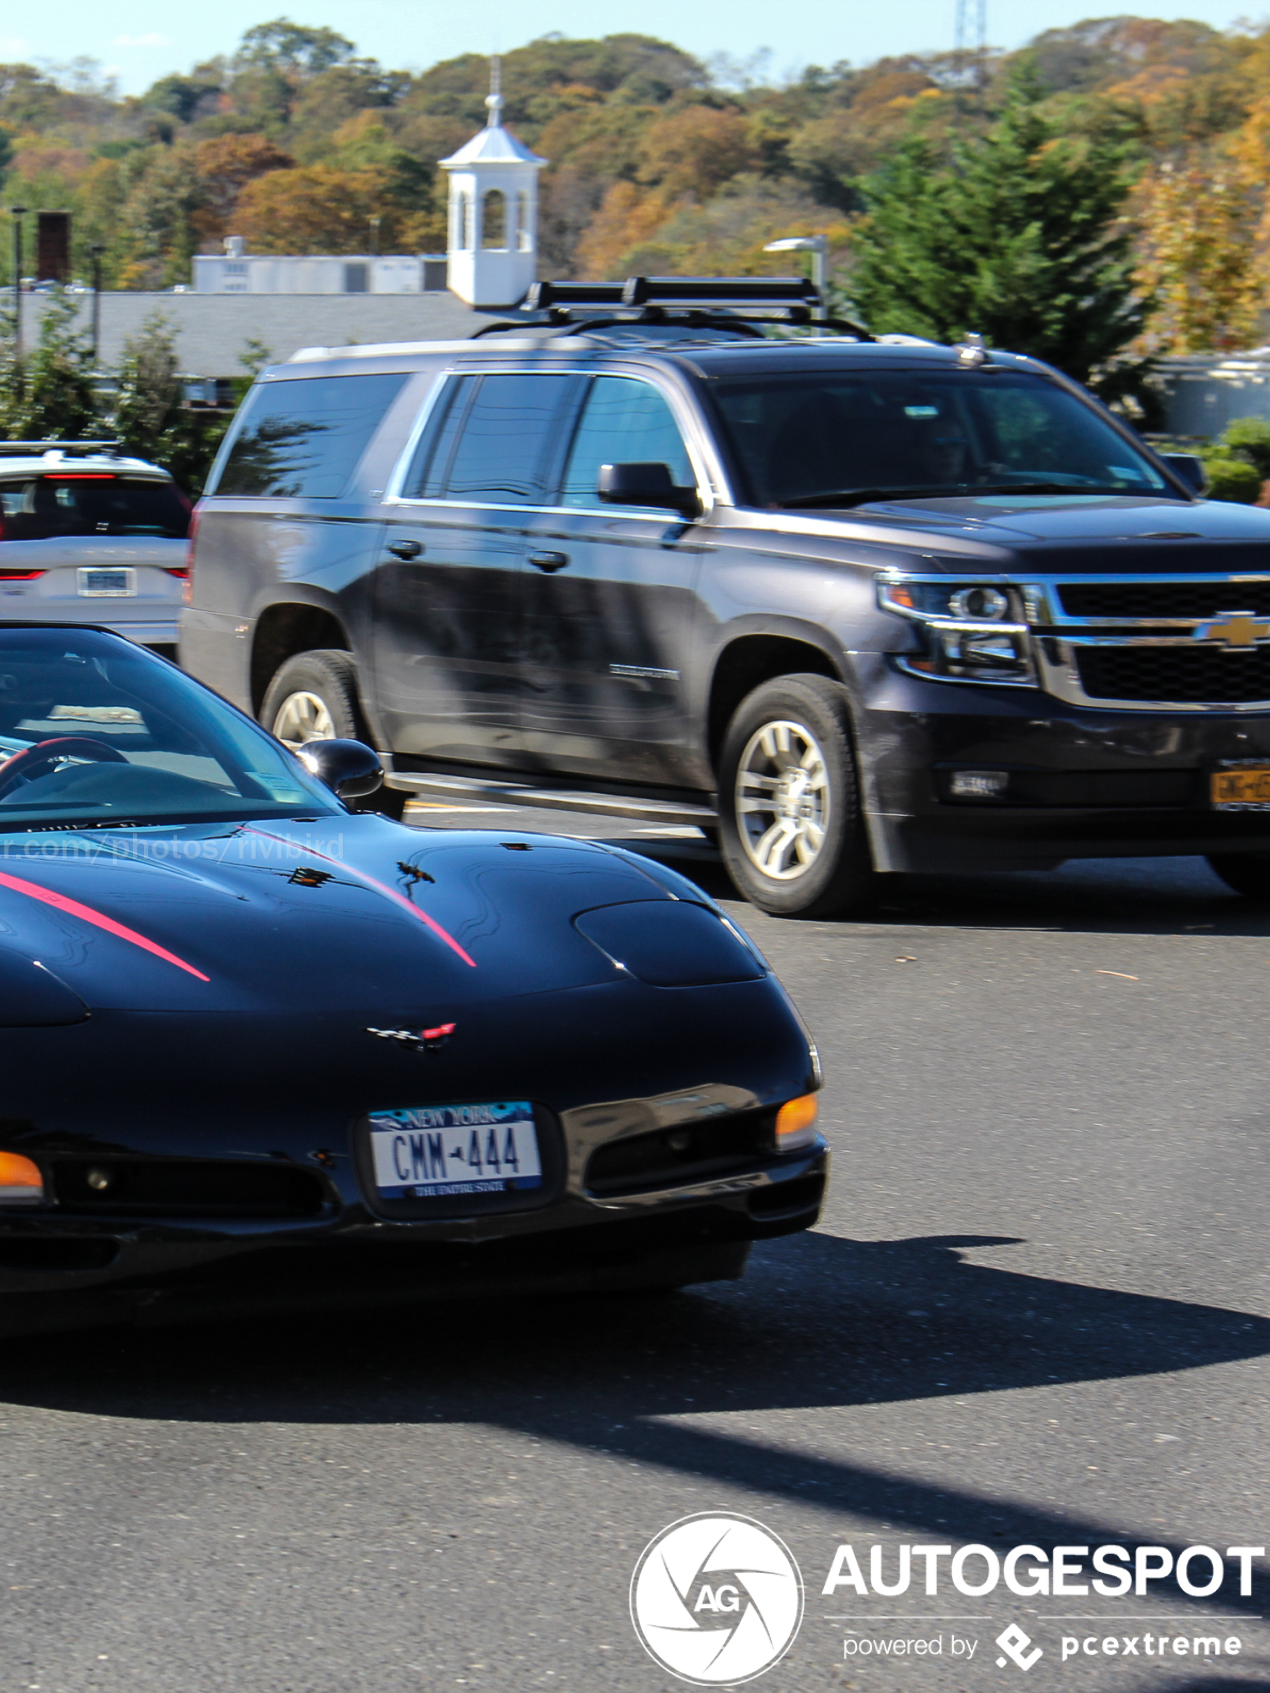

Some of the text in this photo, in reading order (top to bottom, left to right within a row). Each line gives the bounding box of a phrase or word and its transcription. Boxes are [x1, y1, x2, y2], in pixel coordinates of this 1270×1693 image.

[406, 1105, 497, 1129] NEW YORK
[415, 1186, 436, 1197] THE
[475, 1181, 505, 1192] STATE
